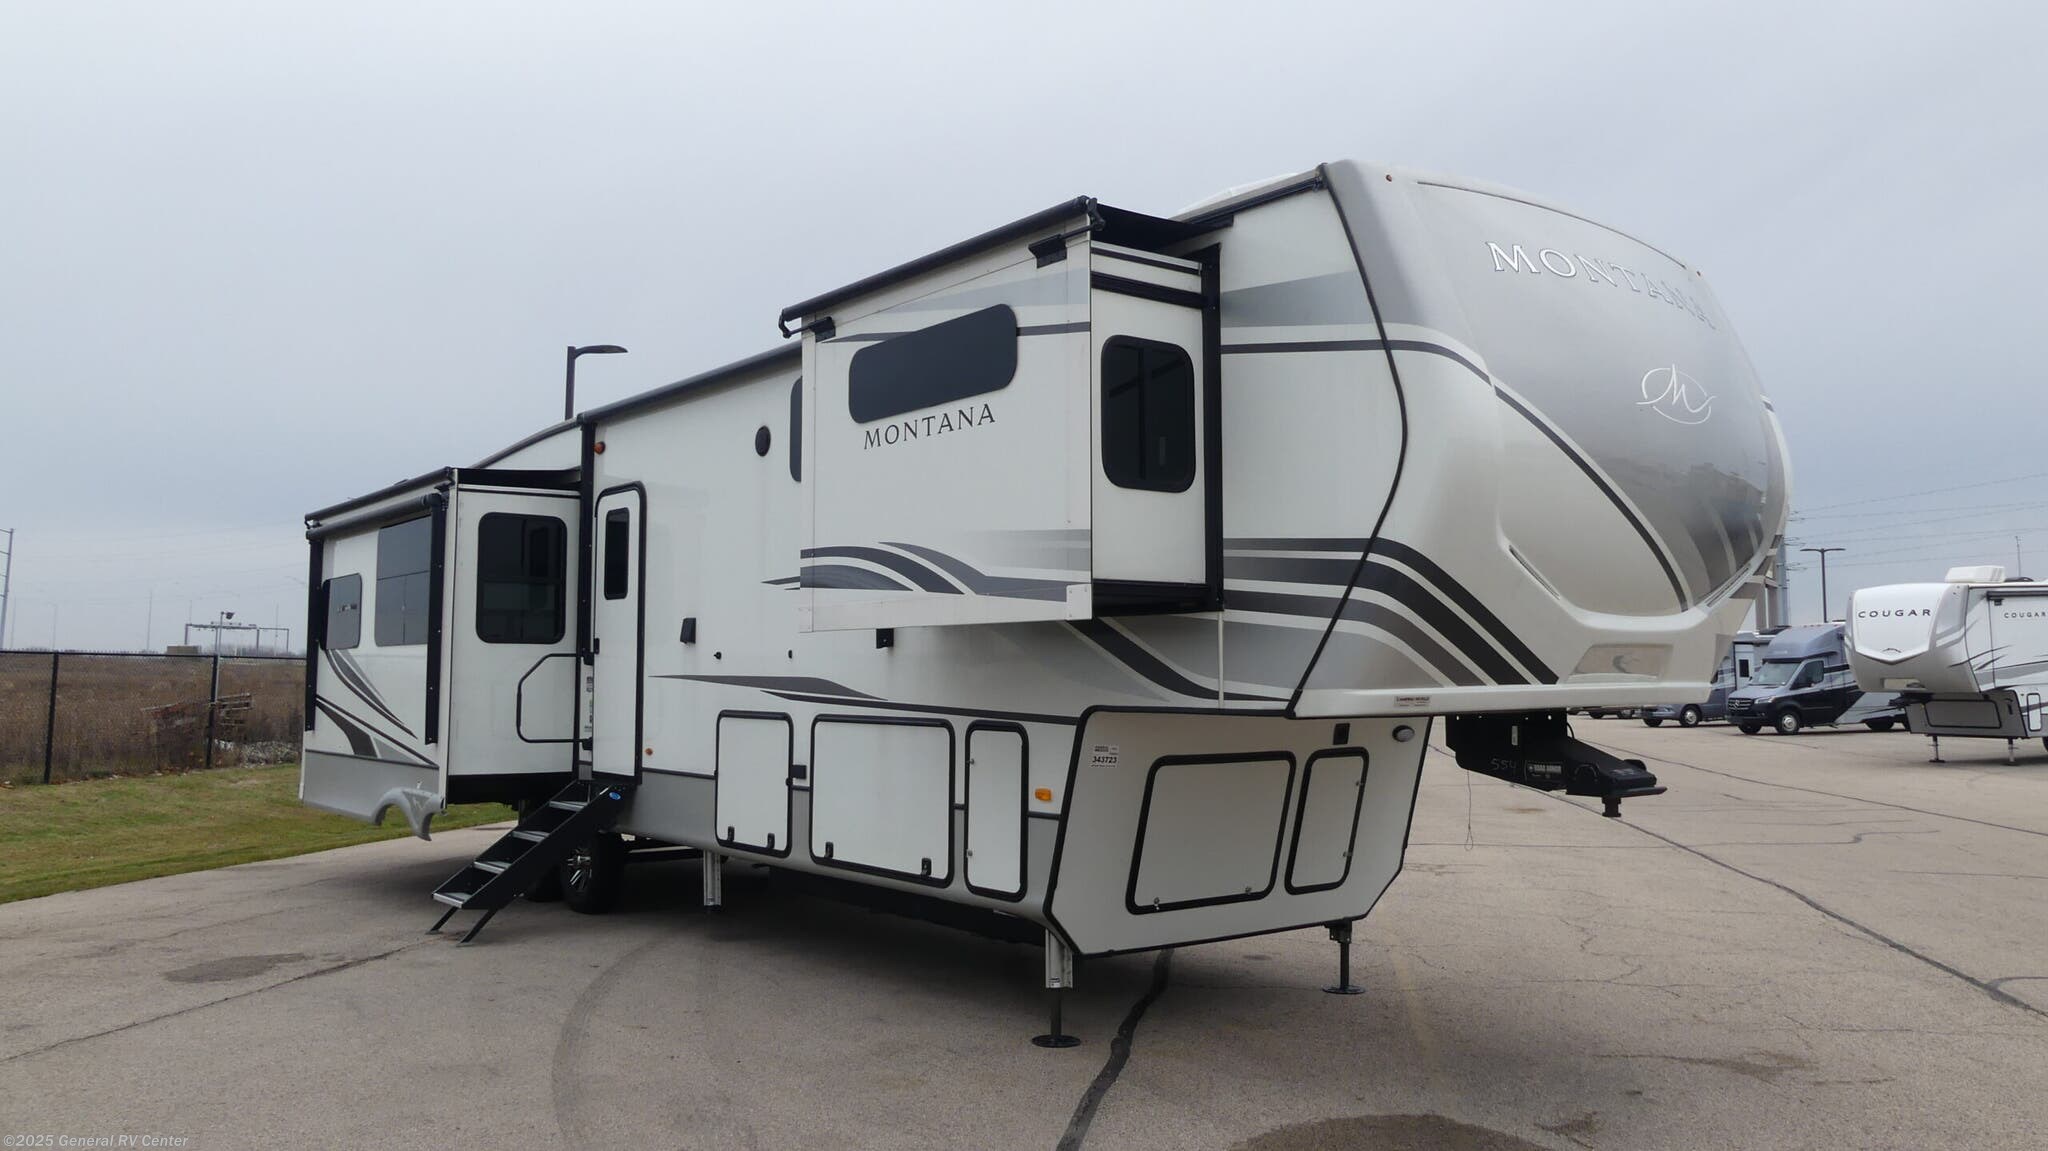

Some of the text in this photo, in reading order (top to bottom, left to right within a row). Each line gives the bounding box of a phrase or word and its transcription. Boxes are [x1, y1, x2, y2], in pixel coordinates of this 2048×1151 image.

[863, 403, 996, 450] MONTANA
[1857, 608, 1932, 619] COUGAR
[2003, 611, 2047, 619] COUGAR
